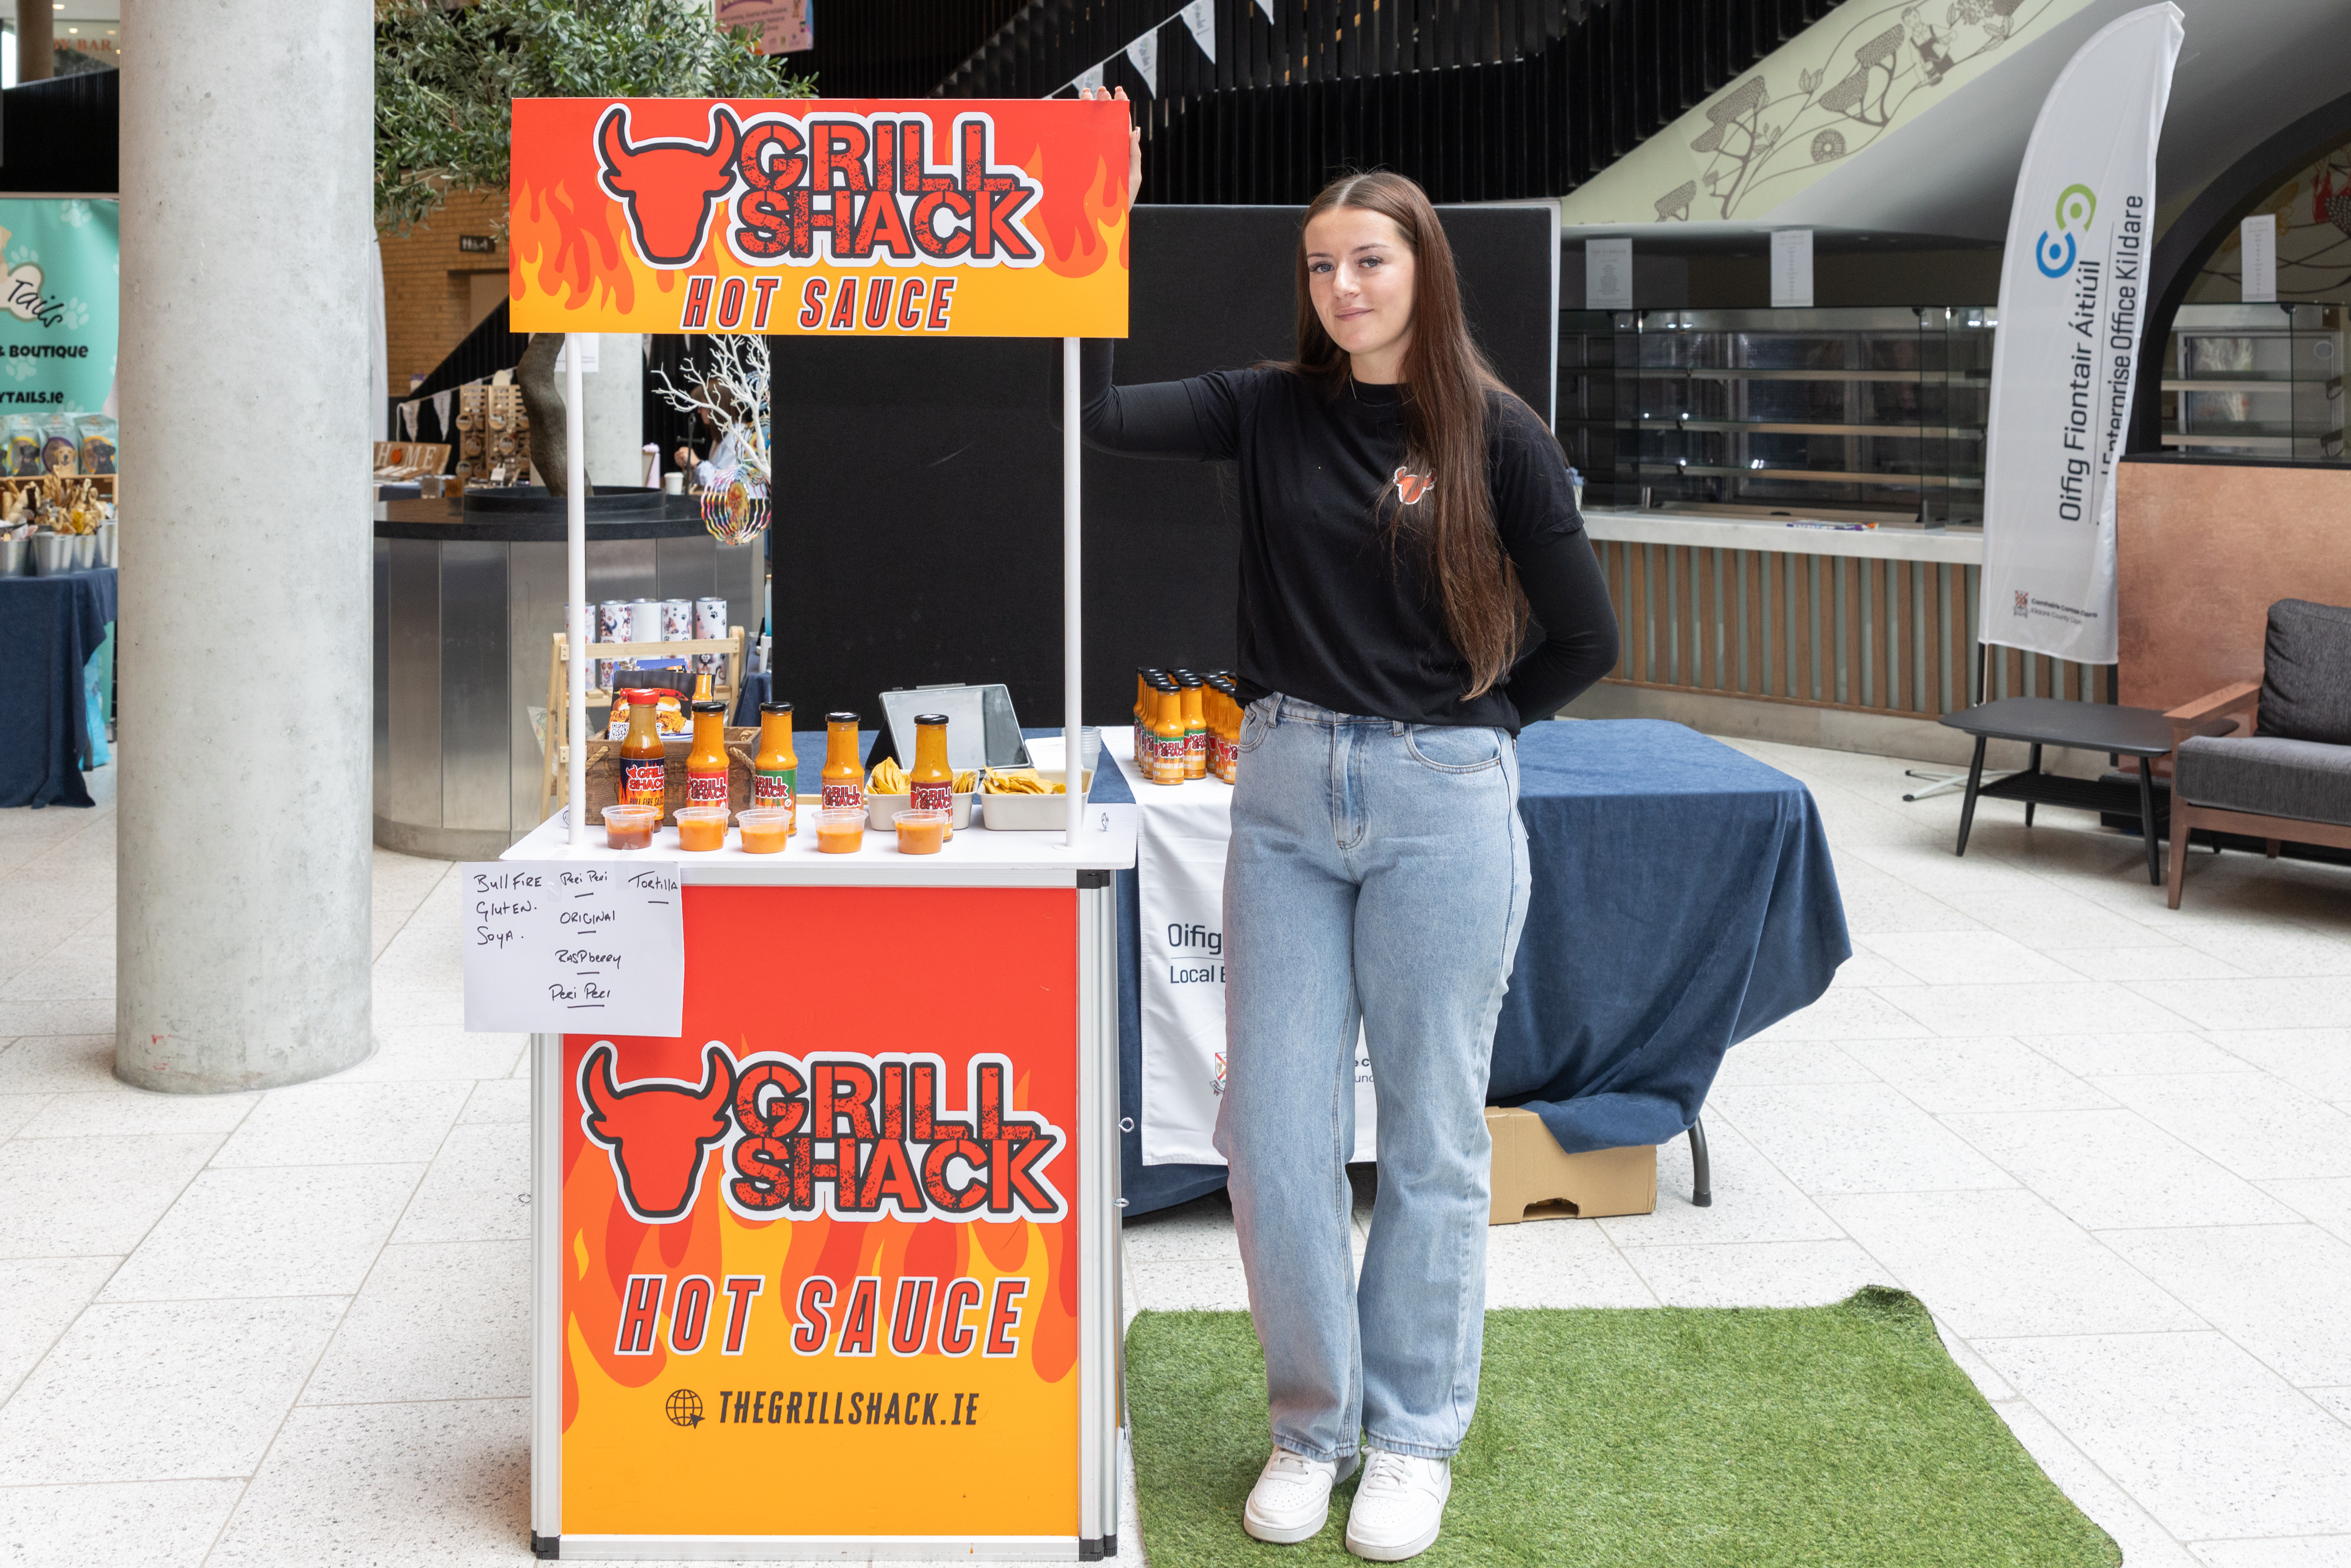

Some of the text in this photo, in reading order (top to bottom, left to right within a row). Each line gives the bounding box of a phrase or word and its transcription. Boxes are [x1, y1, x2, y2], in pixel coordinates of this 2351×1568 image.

[737, 120, 1020, 196] GRILL
[735, 186, 1036, 259] SHACK
[2115, 196, 2143, 280] Kildare
[8, 279, 64, 327] Tails
[681, 277, 956, 330] HOT SAUCE
[2111, 286, 2136, 350] Office
[2059, 260, 2101, 521] Oifig Fiontair Áitiúil
[1160, 748, 1184, 757] SHAC
[637, 766, 665, 779] GRILL
[691, 779, 726, 790] GRILL
[643, 798, 654, 806] FIRE
[691, 786, 726, 799] SHACK
[825, 786, 860, 798] GRILL
[825, 793, 861, 806] SHACK
[919, 788, 952, 800] GRILL
[474, 874, 508, 892] Bull
[1168, 923, 1222, 955] Oifig
[1170, 965, 1214, 984] Local
[731, 1060, 1040, 1143] GRILL
[729, 1135, 1060, 1213] SHACK
[617, 1276, 1028, 1356] HOT SAUCE
[719, 1390, 980, 1426] THEGRILLSHACK.IE
